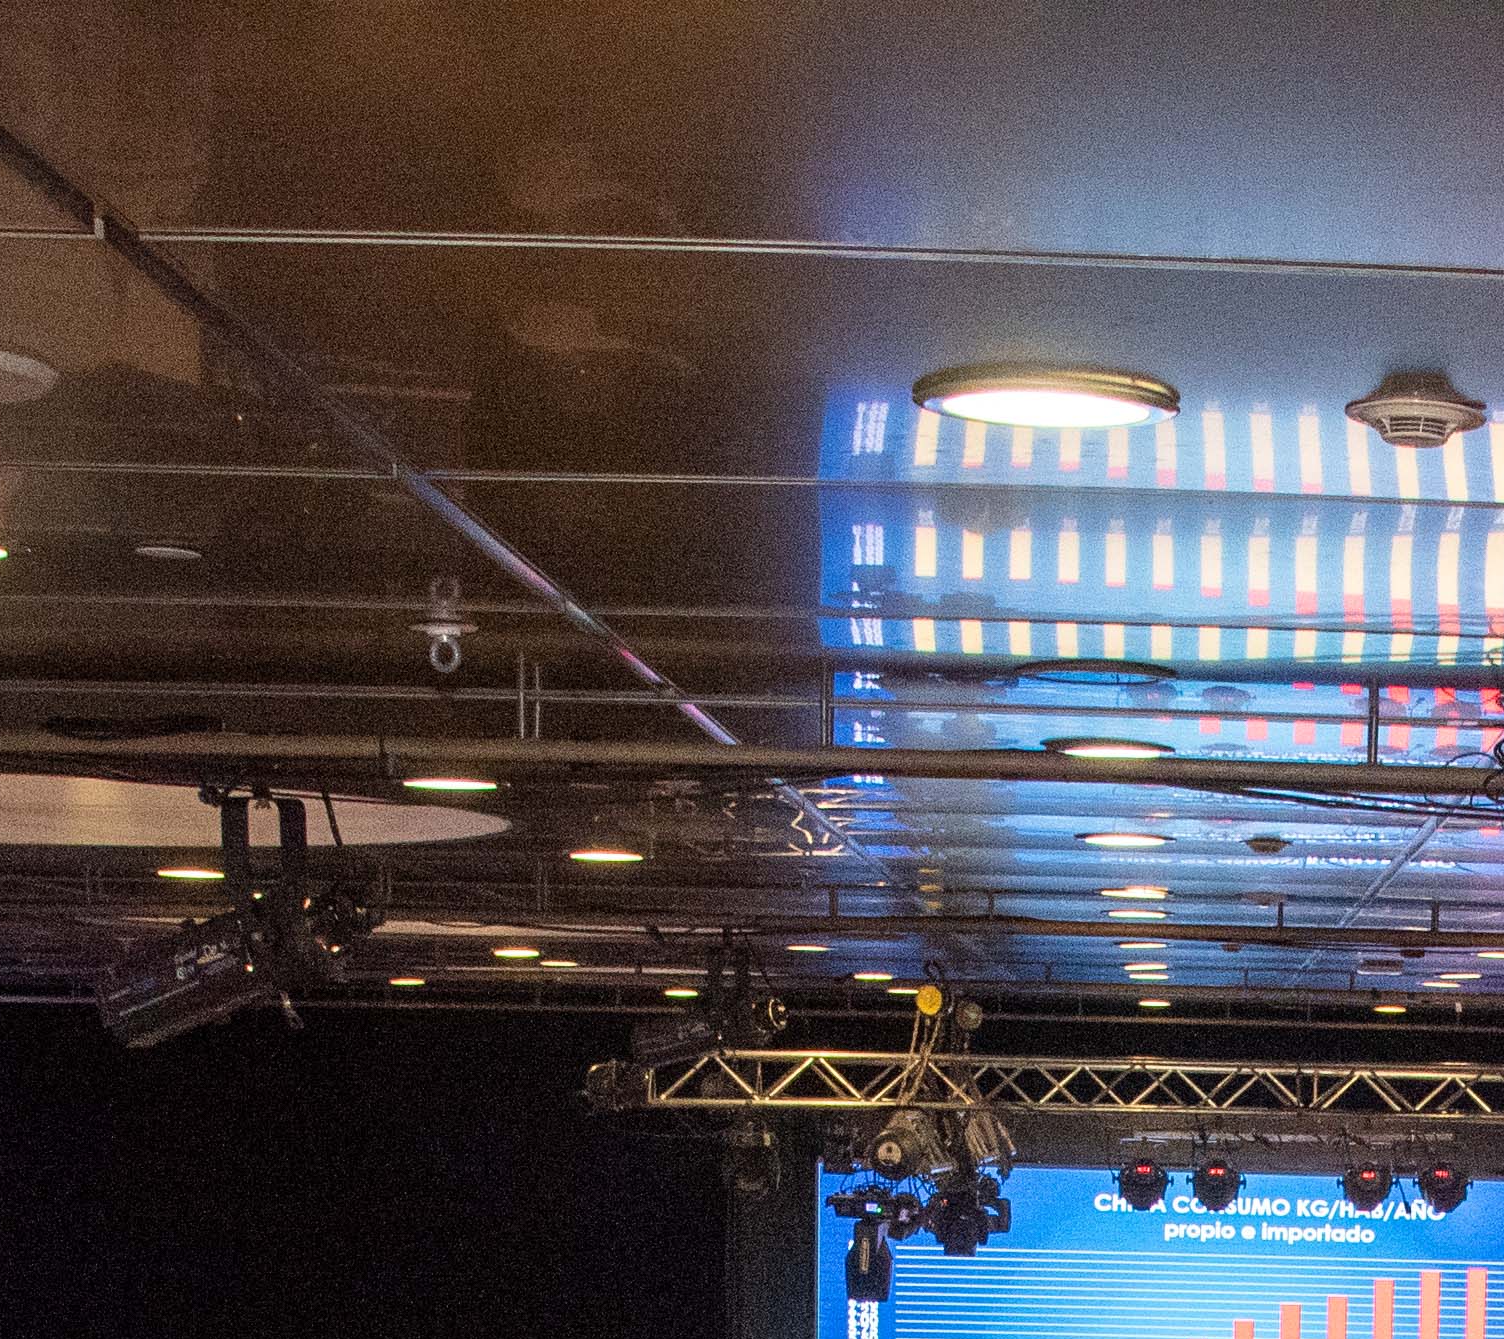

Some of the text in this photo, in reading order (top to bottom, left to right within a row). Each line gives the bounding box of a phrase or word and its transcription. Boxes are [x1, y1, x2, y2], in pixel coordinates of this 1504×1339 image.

[1094, 1193, 1167, 1213] CHA
[1172, 1196, 1291, 1216] COSUMO
[1164, 1221, 1375, 1244] propio e importado
